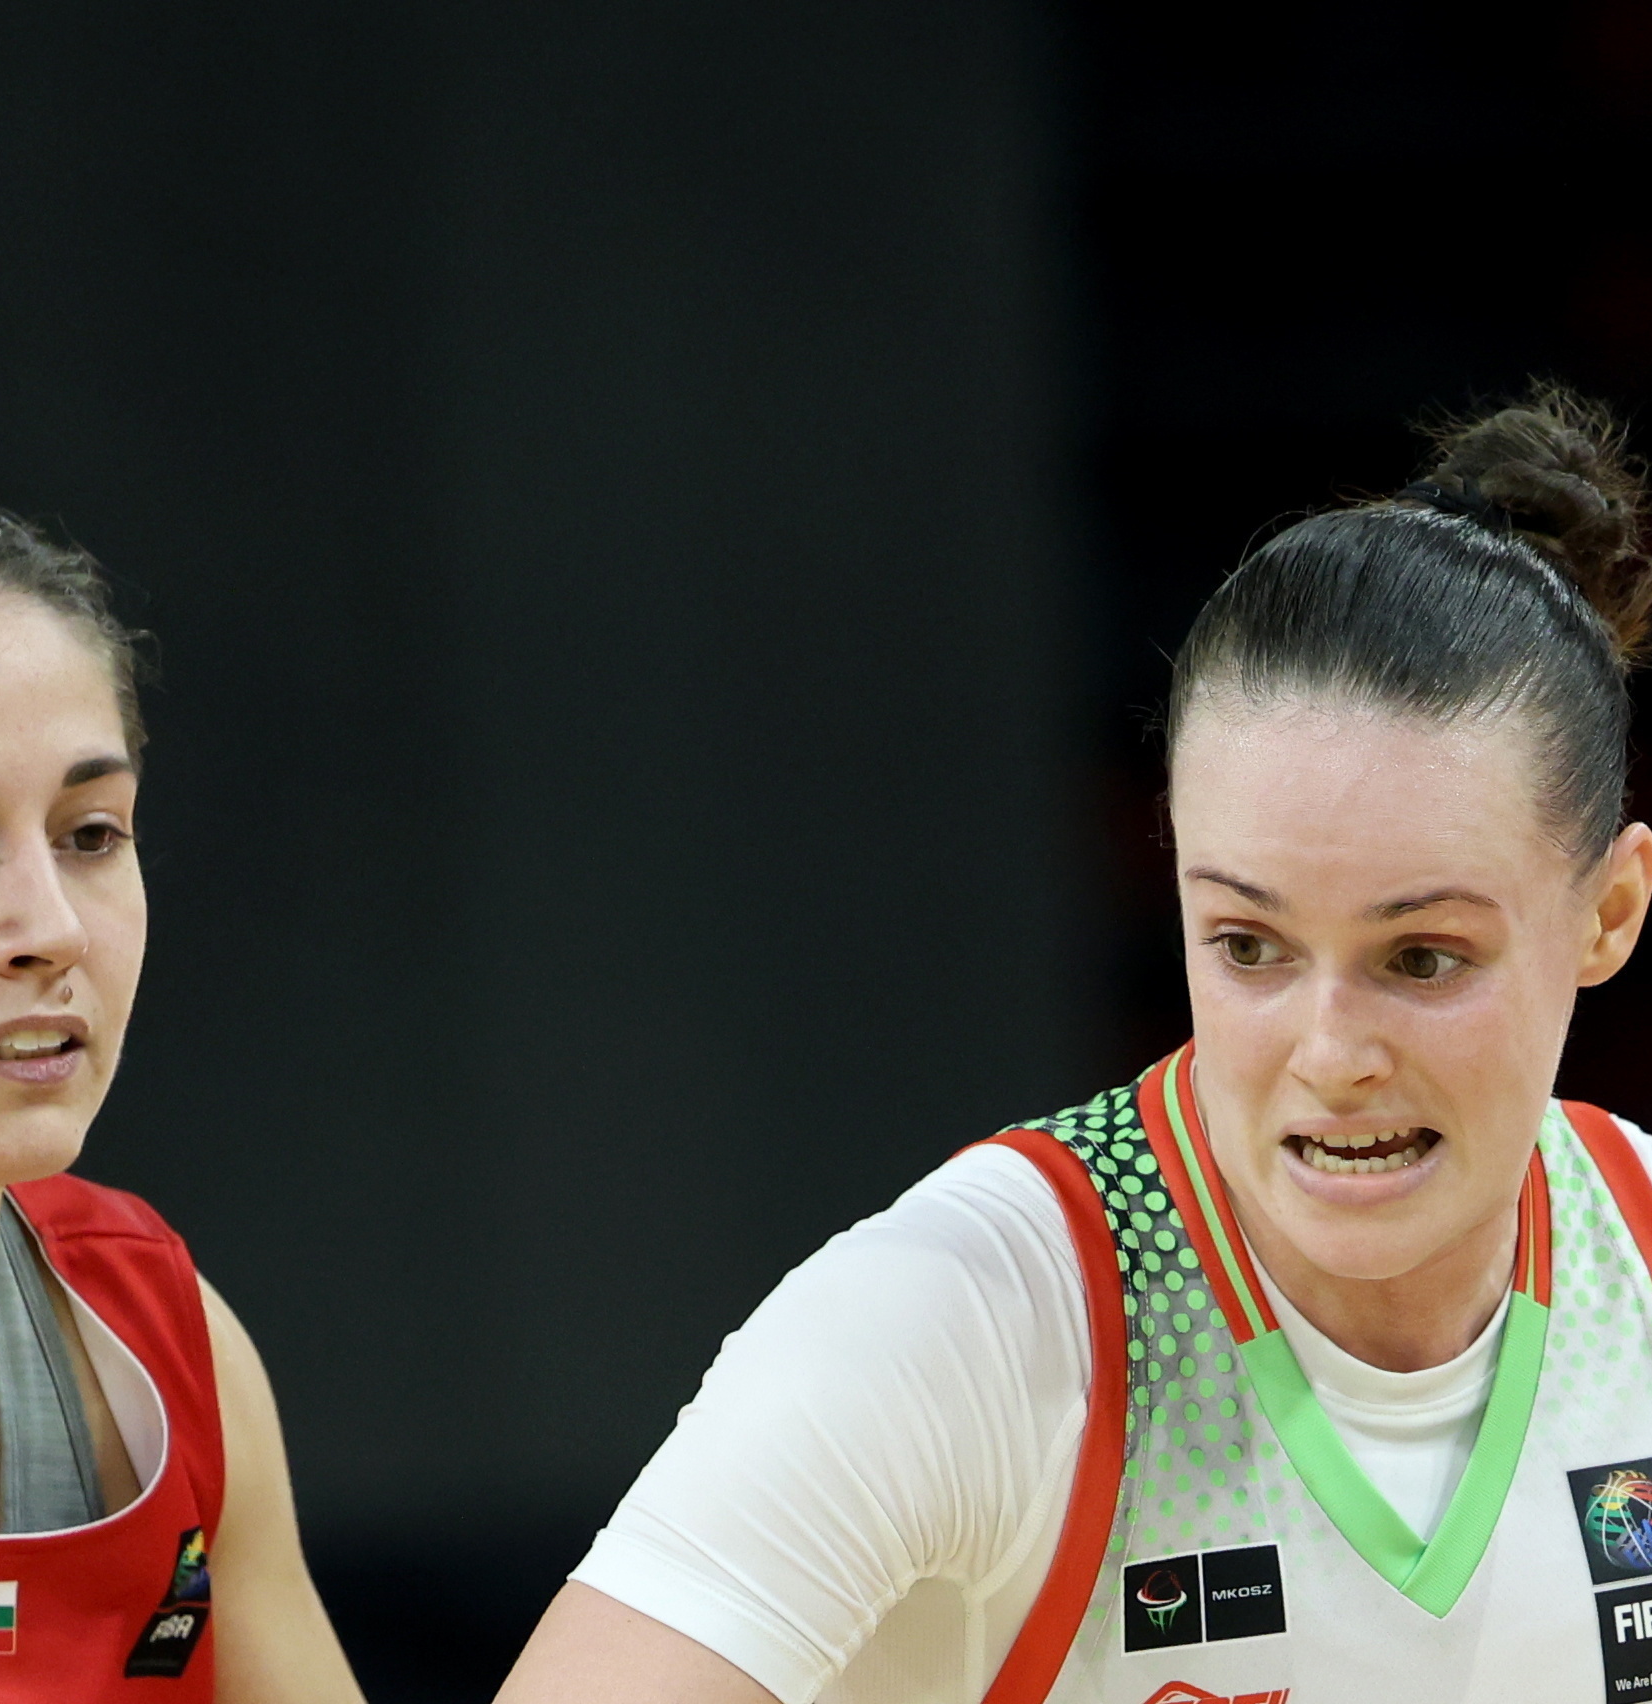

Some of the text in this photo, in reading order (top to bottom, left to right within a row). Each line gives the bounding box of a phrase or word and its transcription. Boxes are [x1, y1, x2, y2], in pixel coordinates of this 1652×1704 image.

[1211, 1583, 1273, 1602] MKOSZ
[1615, 1678, 1632, 1692] We
[1633, 1676, 1650, 1689] Are
